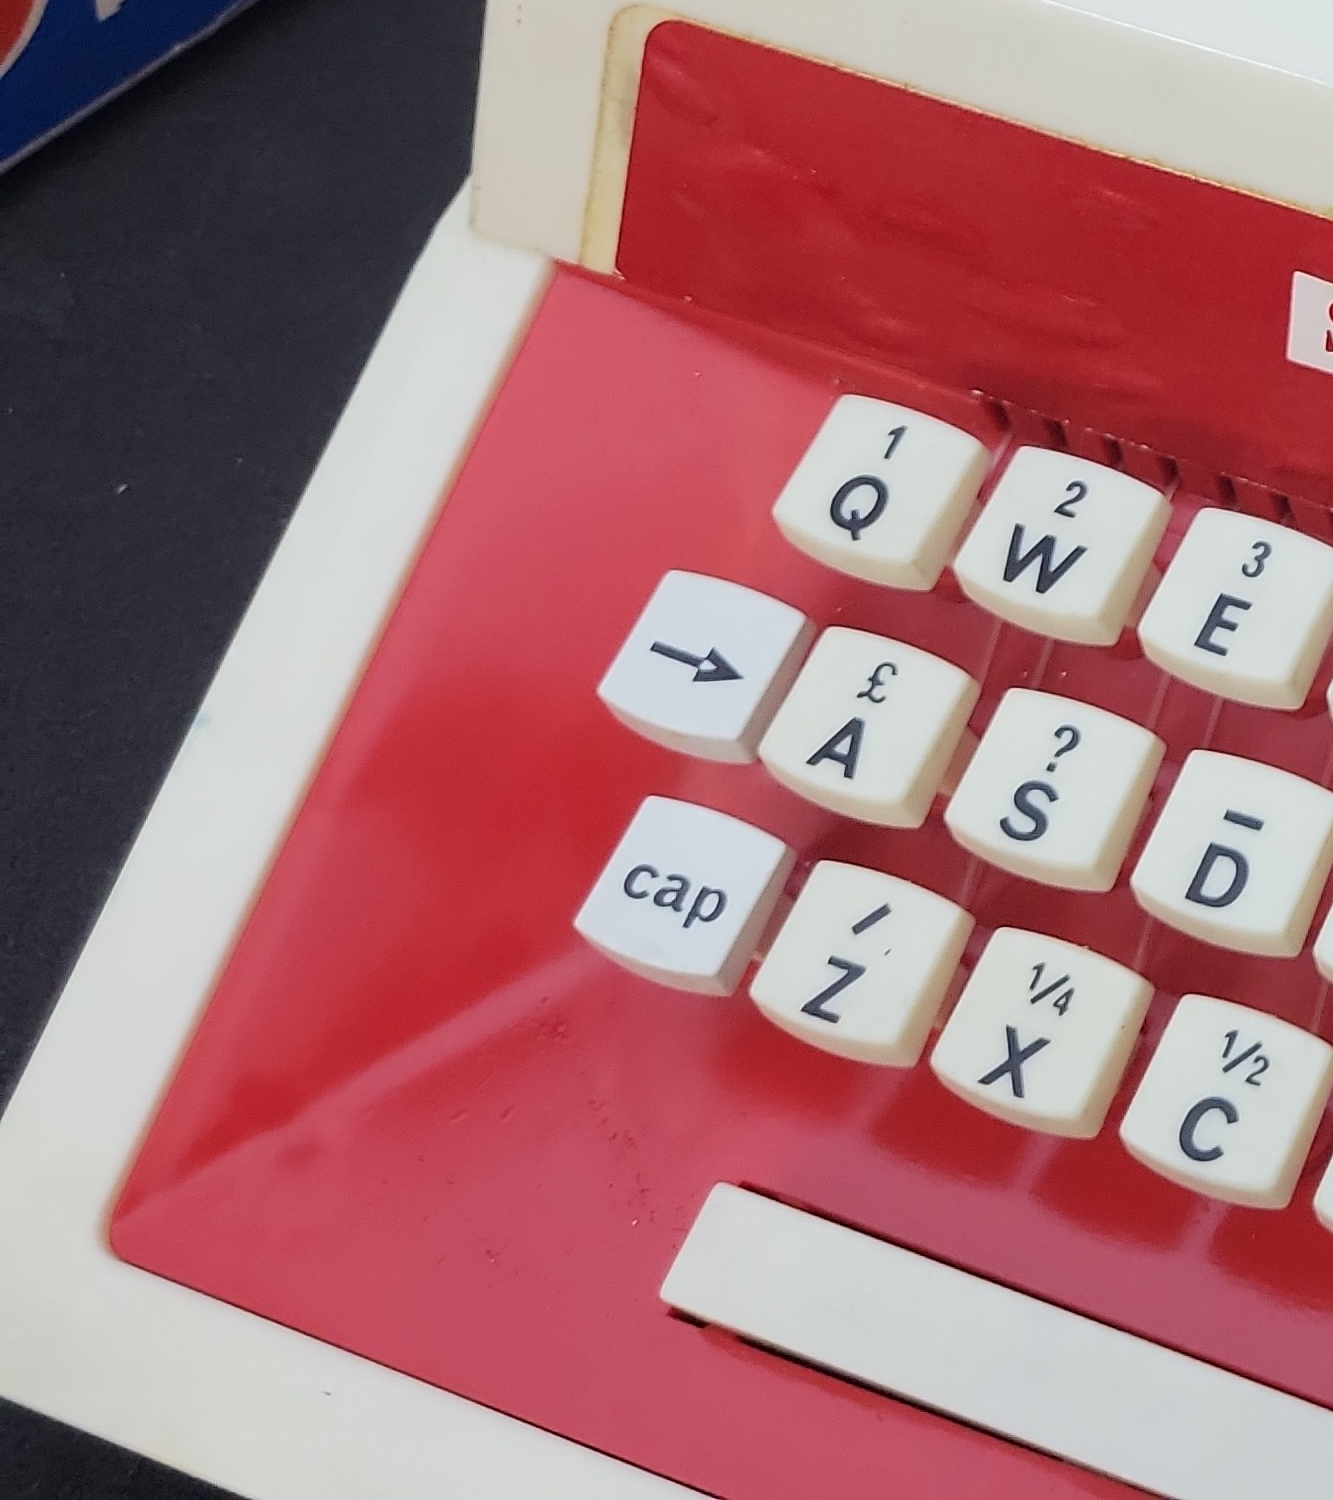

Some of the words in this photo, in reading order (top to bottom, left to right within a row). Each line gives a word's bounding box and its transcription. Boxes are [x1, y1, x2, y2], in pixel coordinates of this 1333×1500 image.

[883, 425, 907, 460] 1
[829, 475, 889, 542] Q
[1053, 480, 1088, 519] 2
[1002, 523, 1087, 595] W
[1241, 541, 1272, 579] 3
[1193, 593, 1252, 657] E
[856, 661, 898, 704] £
[805, 717, 865, 780] A
[1045, 725, 1081, 773] ?
[999, 780, 1059, 842] S
[623, 864, 727, 929] cap
[1184, 842, 1249, 909] D
[800, 955, 866, 1024] Z
[977, 1025, 1051, 1099] X
[1178, 1096, 1239, 1163] C
